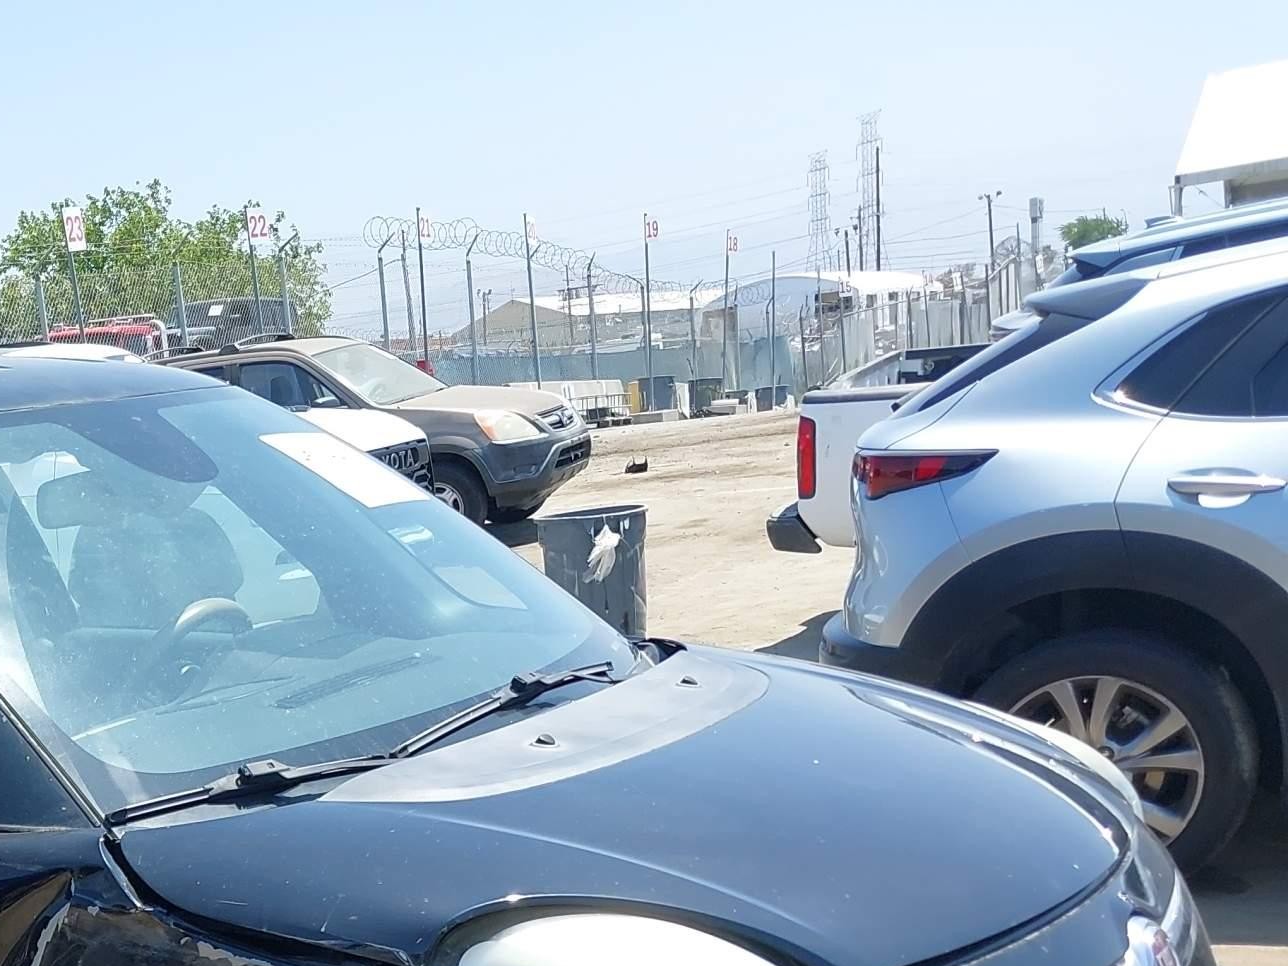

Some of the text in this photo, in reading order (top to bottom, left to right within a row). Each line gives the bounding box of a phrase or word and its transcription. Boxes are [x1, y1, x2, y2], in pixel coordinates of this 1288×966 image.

[65, 215, 83, 242] 23
[249, 215, 267, 238] 22
[646, 220, 659, 238] 19
[728, 236, 738, 252] 18
[839, 281, 852, 294] 15
